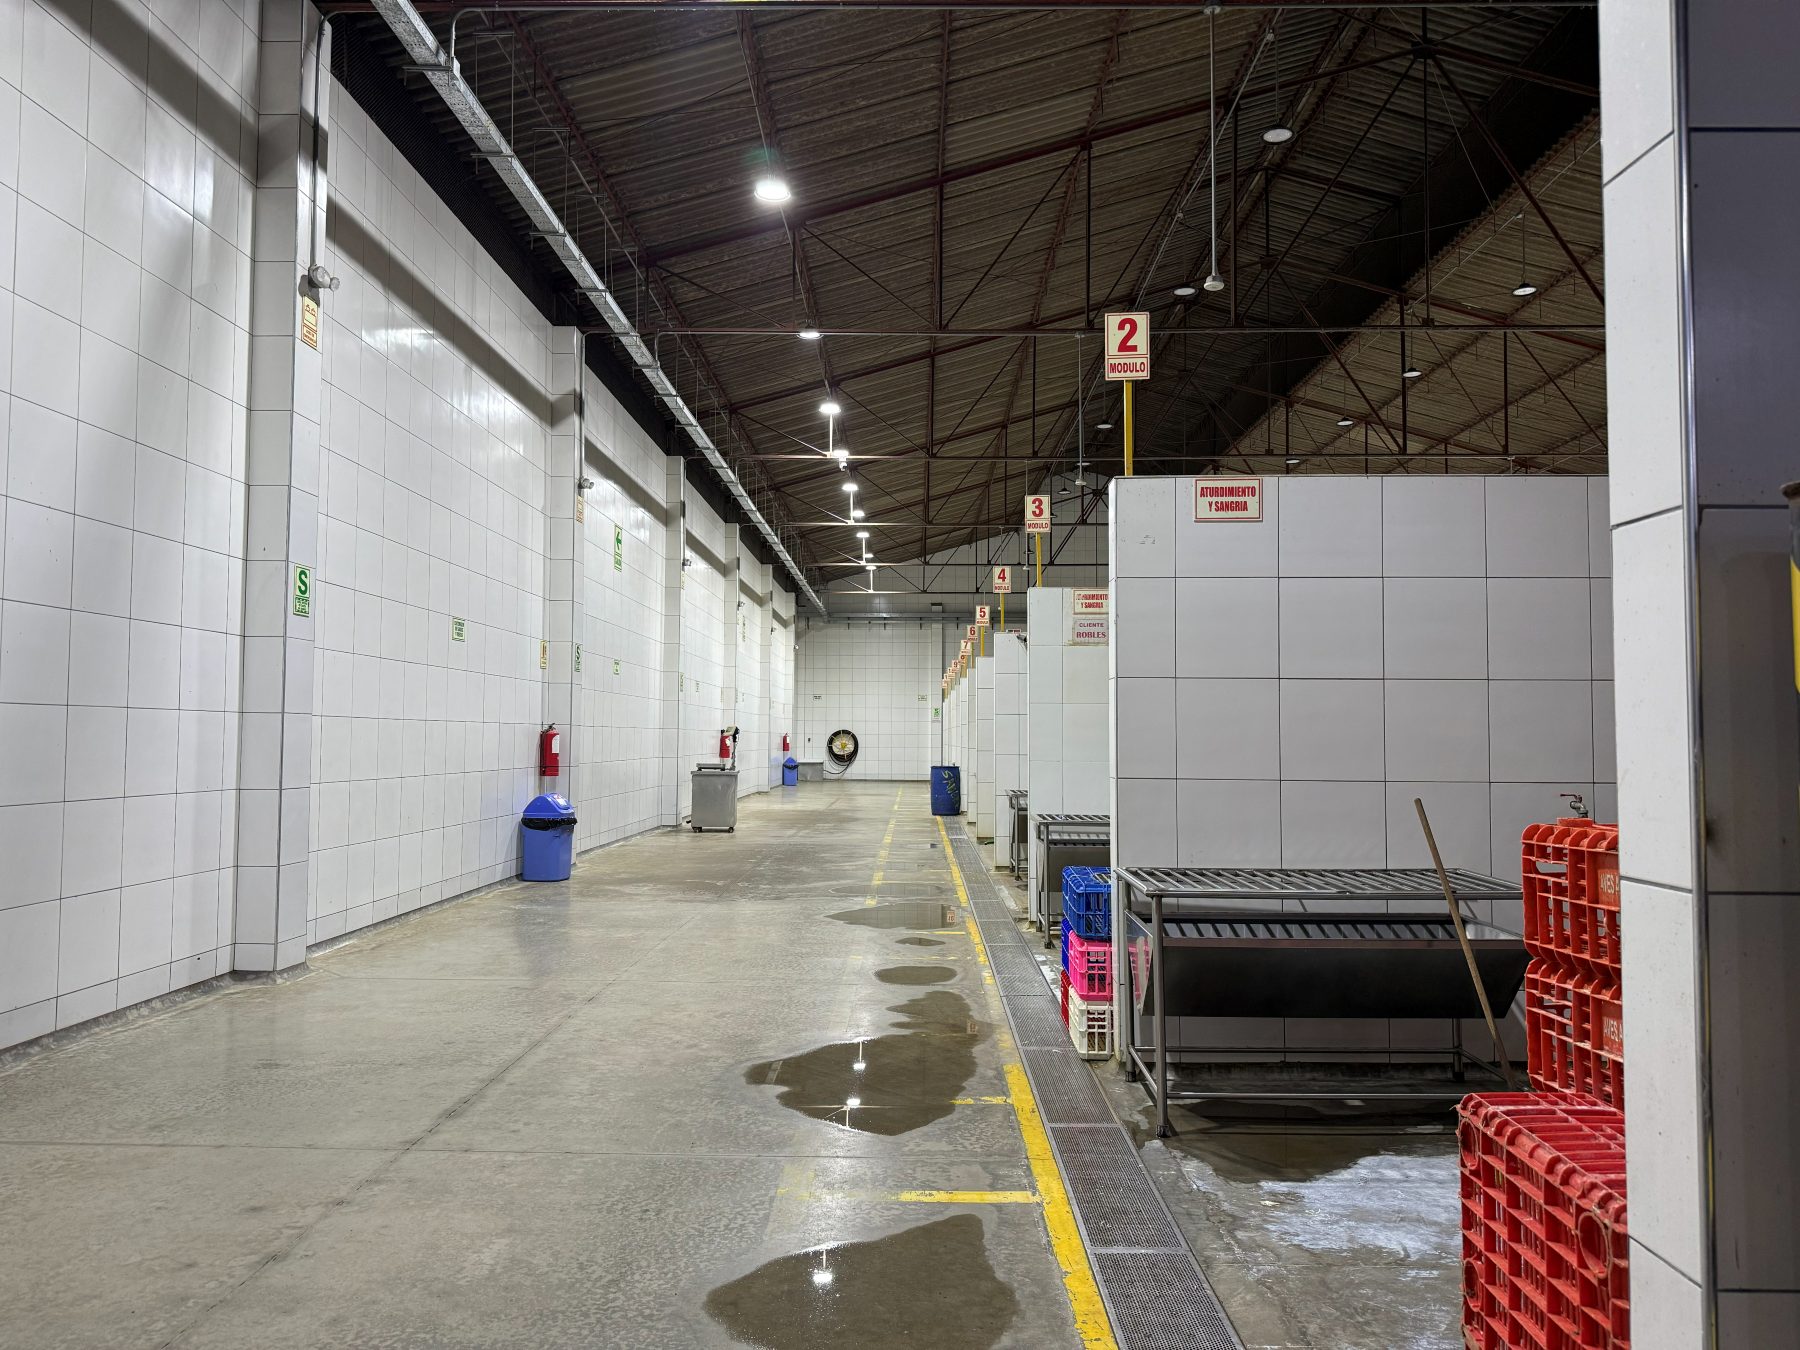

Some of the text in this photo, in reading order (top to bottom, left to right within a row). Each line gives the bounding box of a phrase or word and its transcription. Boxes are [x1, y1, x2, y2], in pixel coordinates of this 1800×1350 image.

[1117, 317, 1138, 353] 2
[1109, 361, 1146, 374] MODULO
[1199, 486, 1257, 498] ATURDIMIENTO
[1031, 497, 1044, 518] 3
[1207, 500, 1249, 512] Y SANGRIA
[997, 567, 1007, 582] 4
[297, 569, 308, 596] S
[979, 607, 986, 618] 5
[970, 627, 976, 635] 6
[1076, 631, 1107, 639] ROBLES
